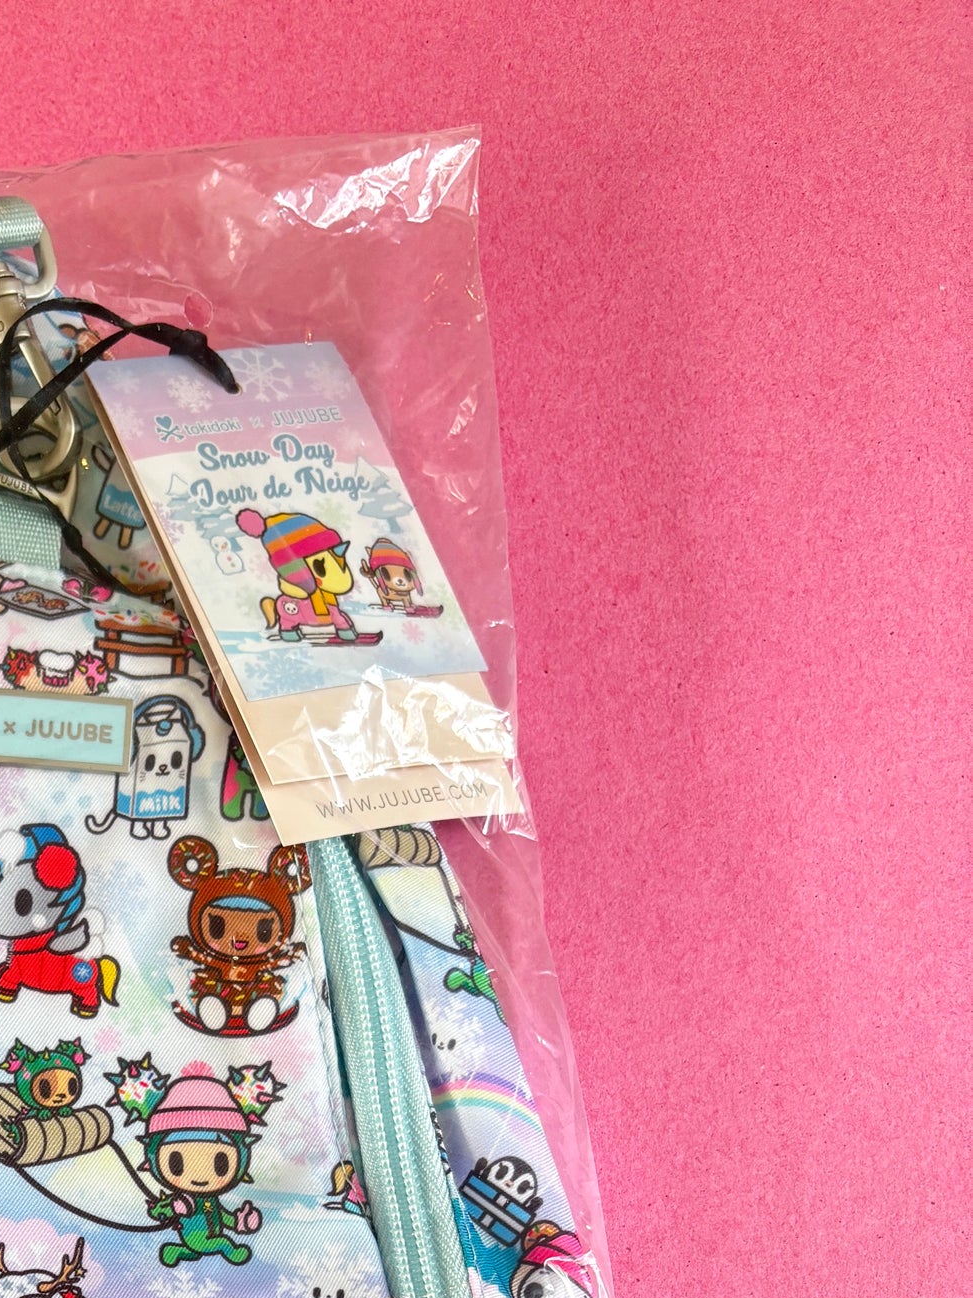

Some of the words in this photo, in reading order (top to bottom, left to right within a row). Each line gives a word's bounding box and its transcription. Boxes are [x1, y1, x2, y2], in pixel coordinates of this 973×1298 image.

[184, 417, 241, 436] tokidoki
[272, 407, 344, 427] JUJUBE
[196, 443, 270, 472] Snow
[272, 434, 335, 468] Day
[190, 478, 257, 508] Jour
[263, 475, 293, 499] de
[294, 466, 371, 500] Neige
[25, 719, 113, 744] JUJUBE
[315, 783, 489, 819] WWW.JUJUBE.COM
